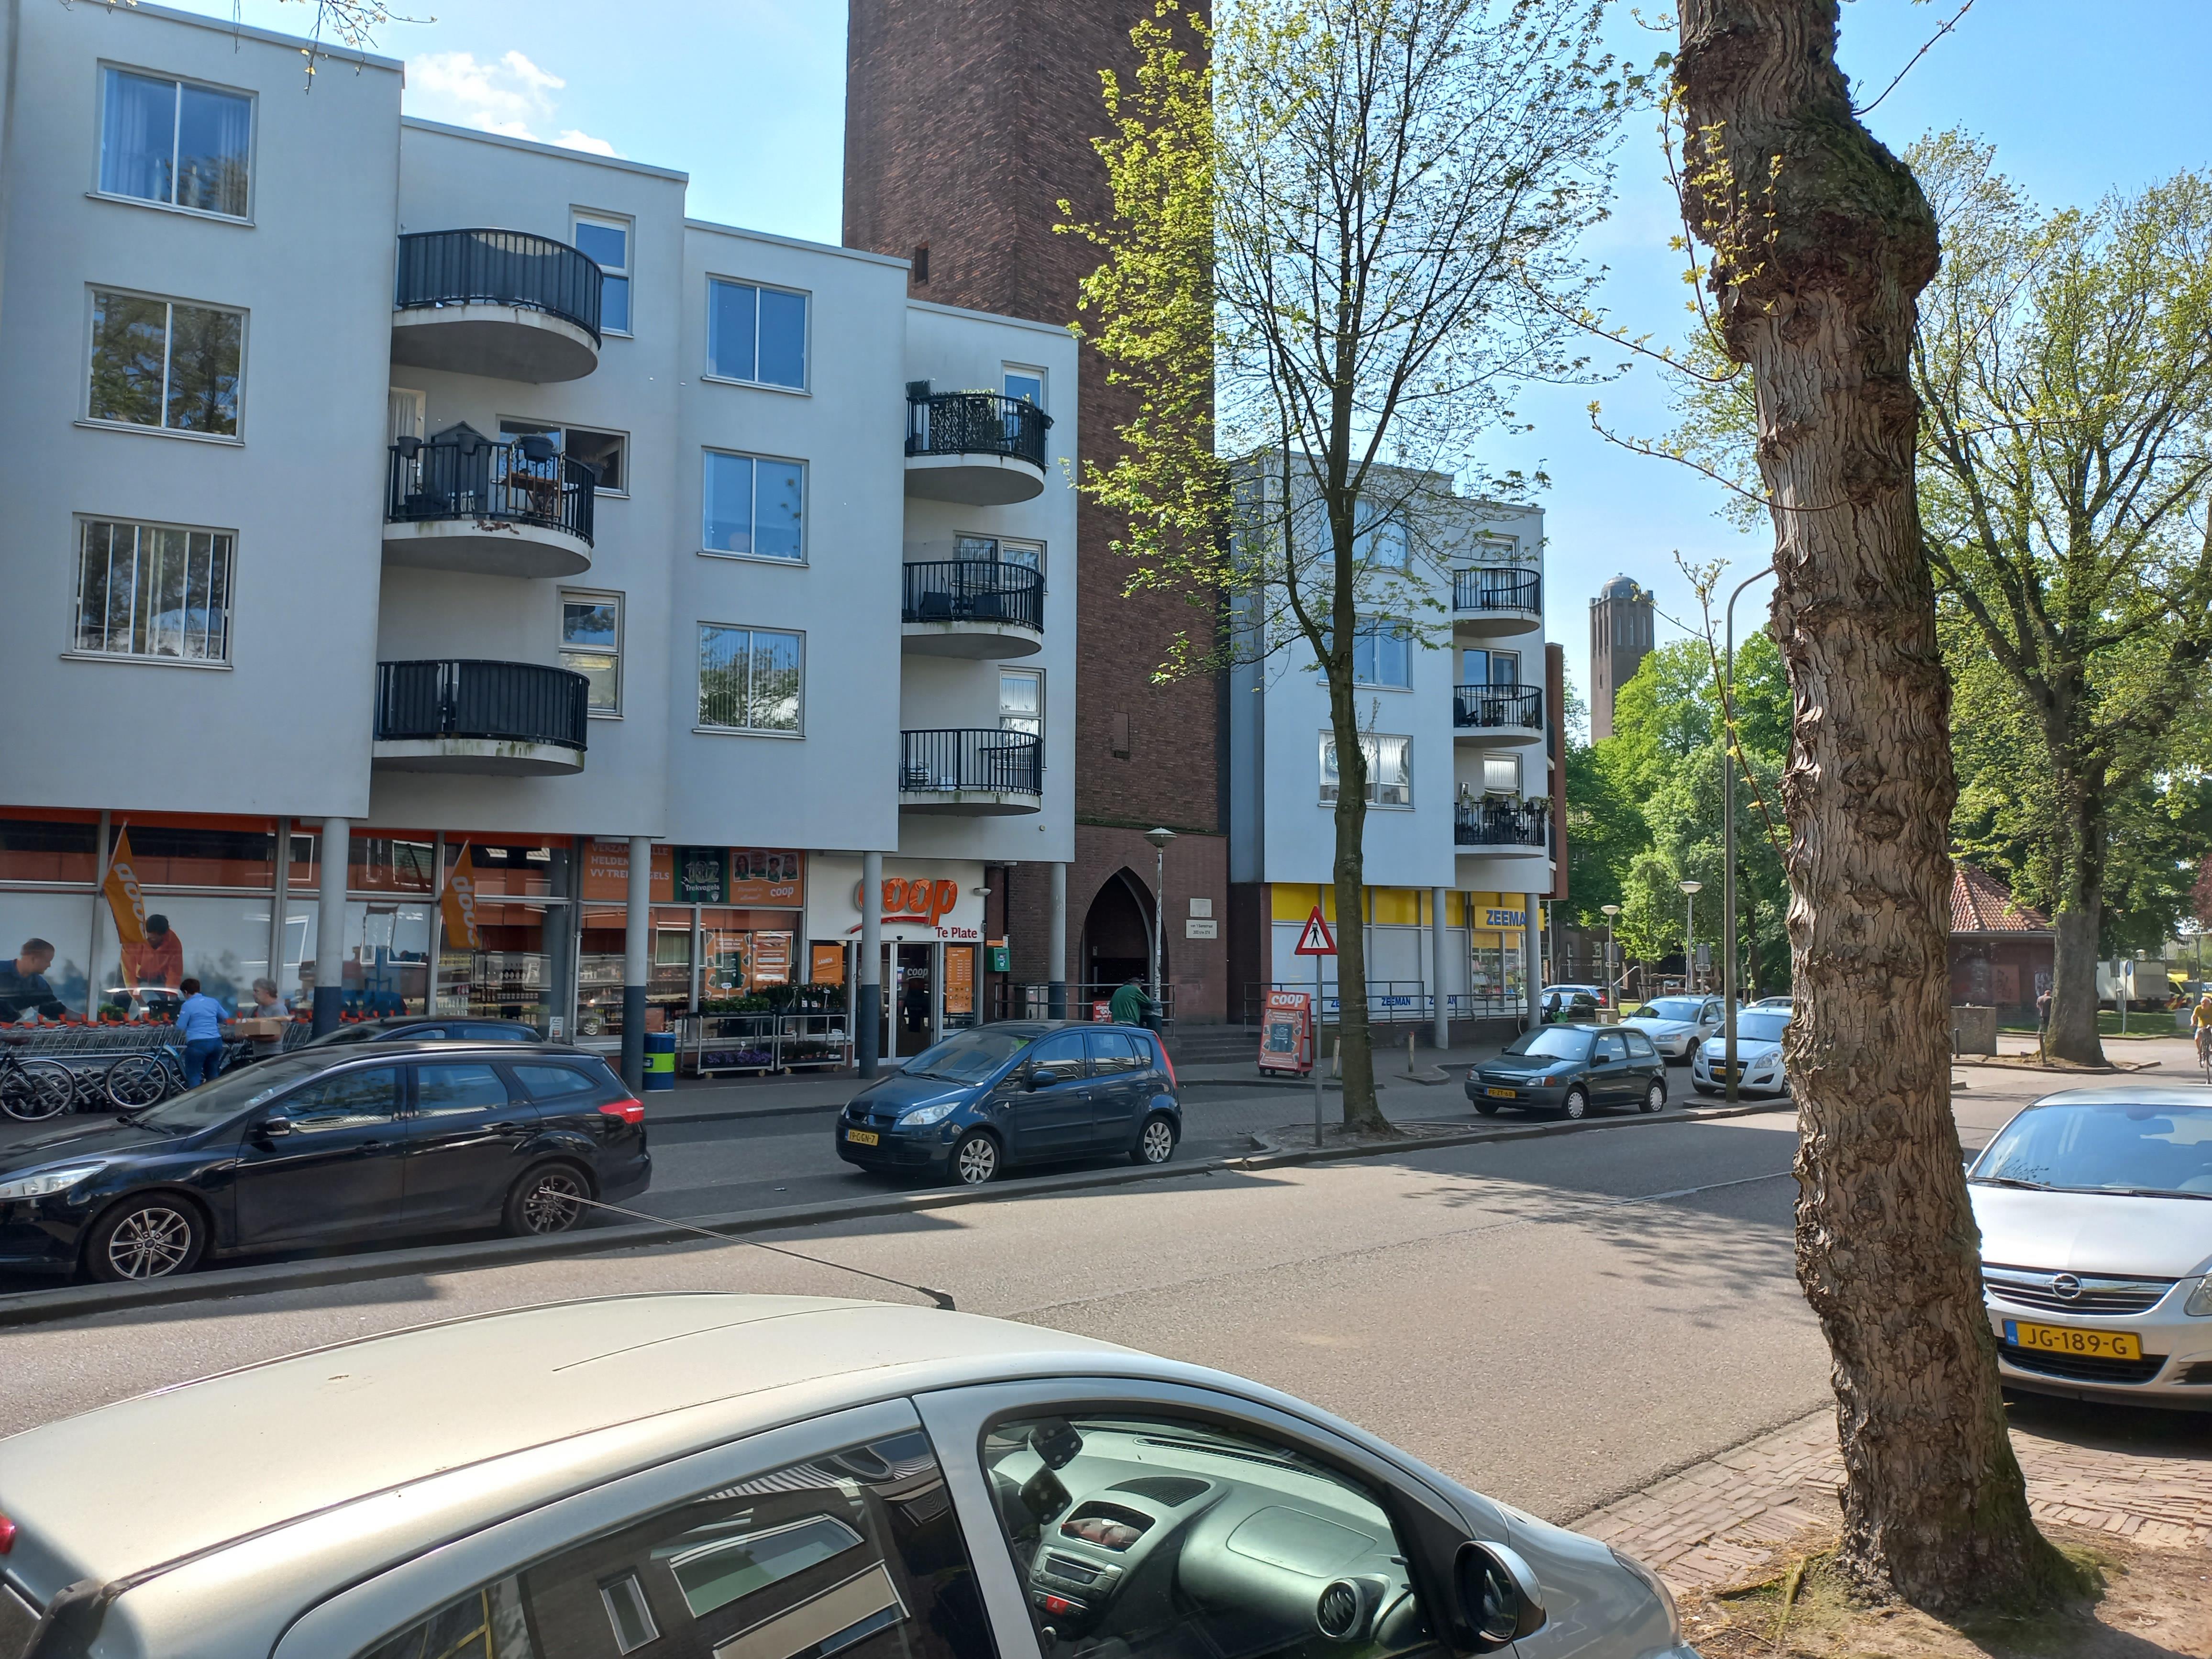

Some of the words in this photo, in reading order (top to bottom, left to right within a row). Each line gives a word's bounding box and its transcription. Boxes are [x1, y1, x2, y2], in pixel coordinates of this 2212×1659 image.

[592, 844, 629, 853] VERZAM
[591, 855, 629, 865] HELDEN
[590, 869, 605, 877] VV
[607, 869, 670, 880] TREGELS
[685, 860, 719, 884] 102
[770, 886, 794, 898] coop
[858, 878, 958, 926] oop
[1486, 910, 1526, 927] ZEEMA
[935, 927, 948, 938] Te
[951, 927, 977, 938] Plate
[907, 968, 929, 979] coop
[1381, 996, 1411, 1006] ZEEMAN
[2027, 1328, 2127, 1355] JG-189-G
